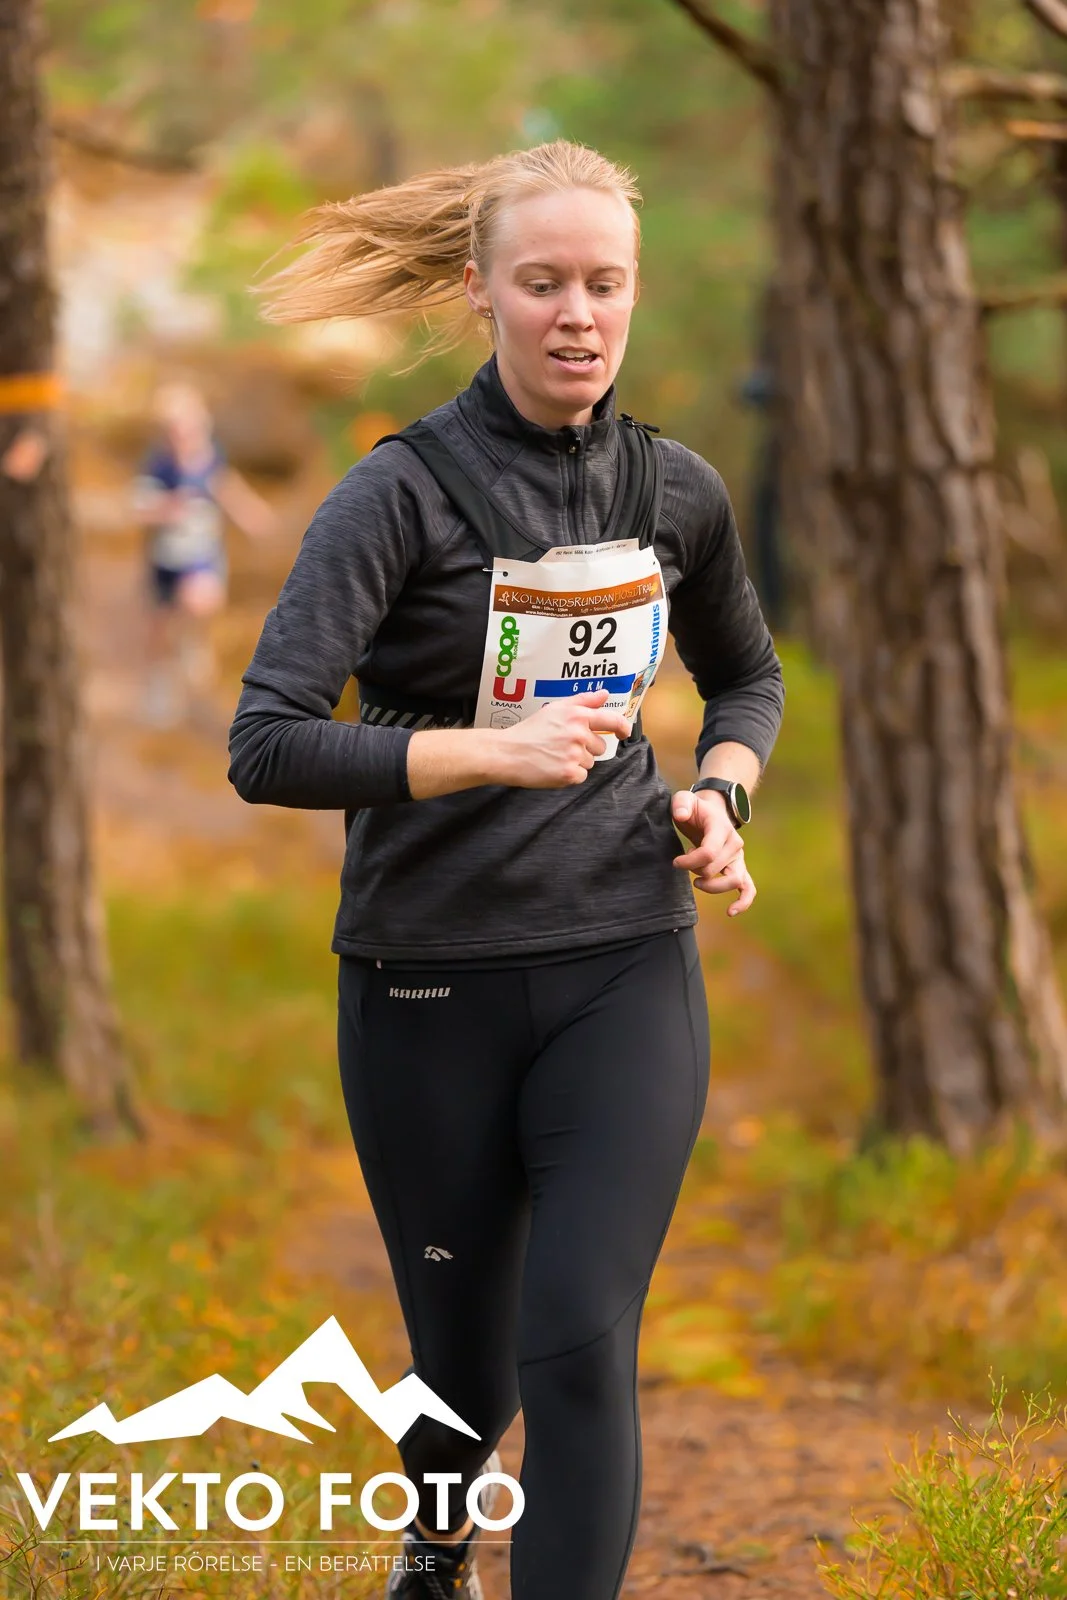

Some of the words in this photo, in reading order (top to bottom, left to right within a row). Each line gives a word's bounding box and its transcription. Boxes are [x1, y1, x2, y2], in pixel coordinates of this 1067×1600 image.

[568, 617, 617, 657] 92
[495, 616, 520, 677] coop
[561, 658, 618, 679] Maria
[572, 682, 579, 692] 6
[490, 701, 523, 710] UMARA
[389, 987, 451, 999] KARHU
